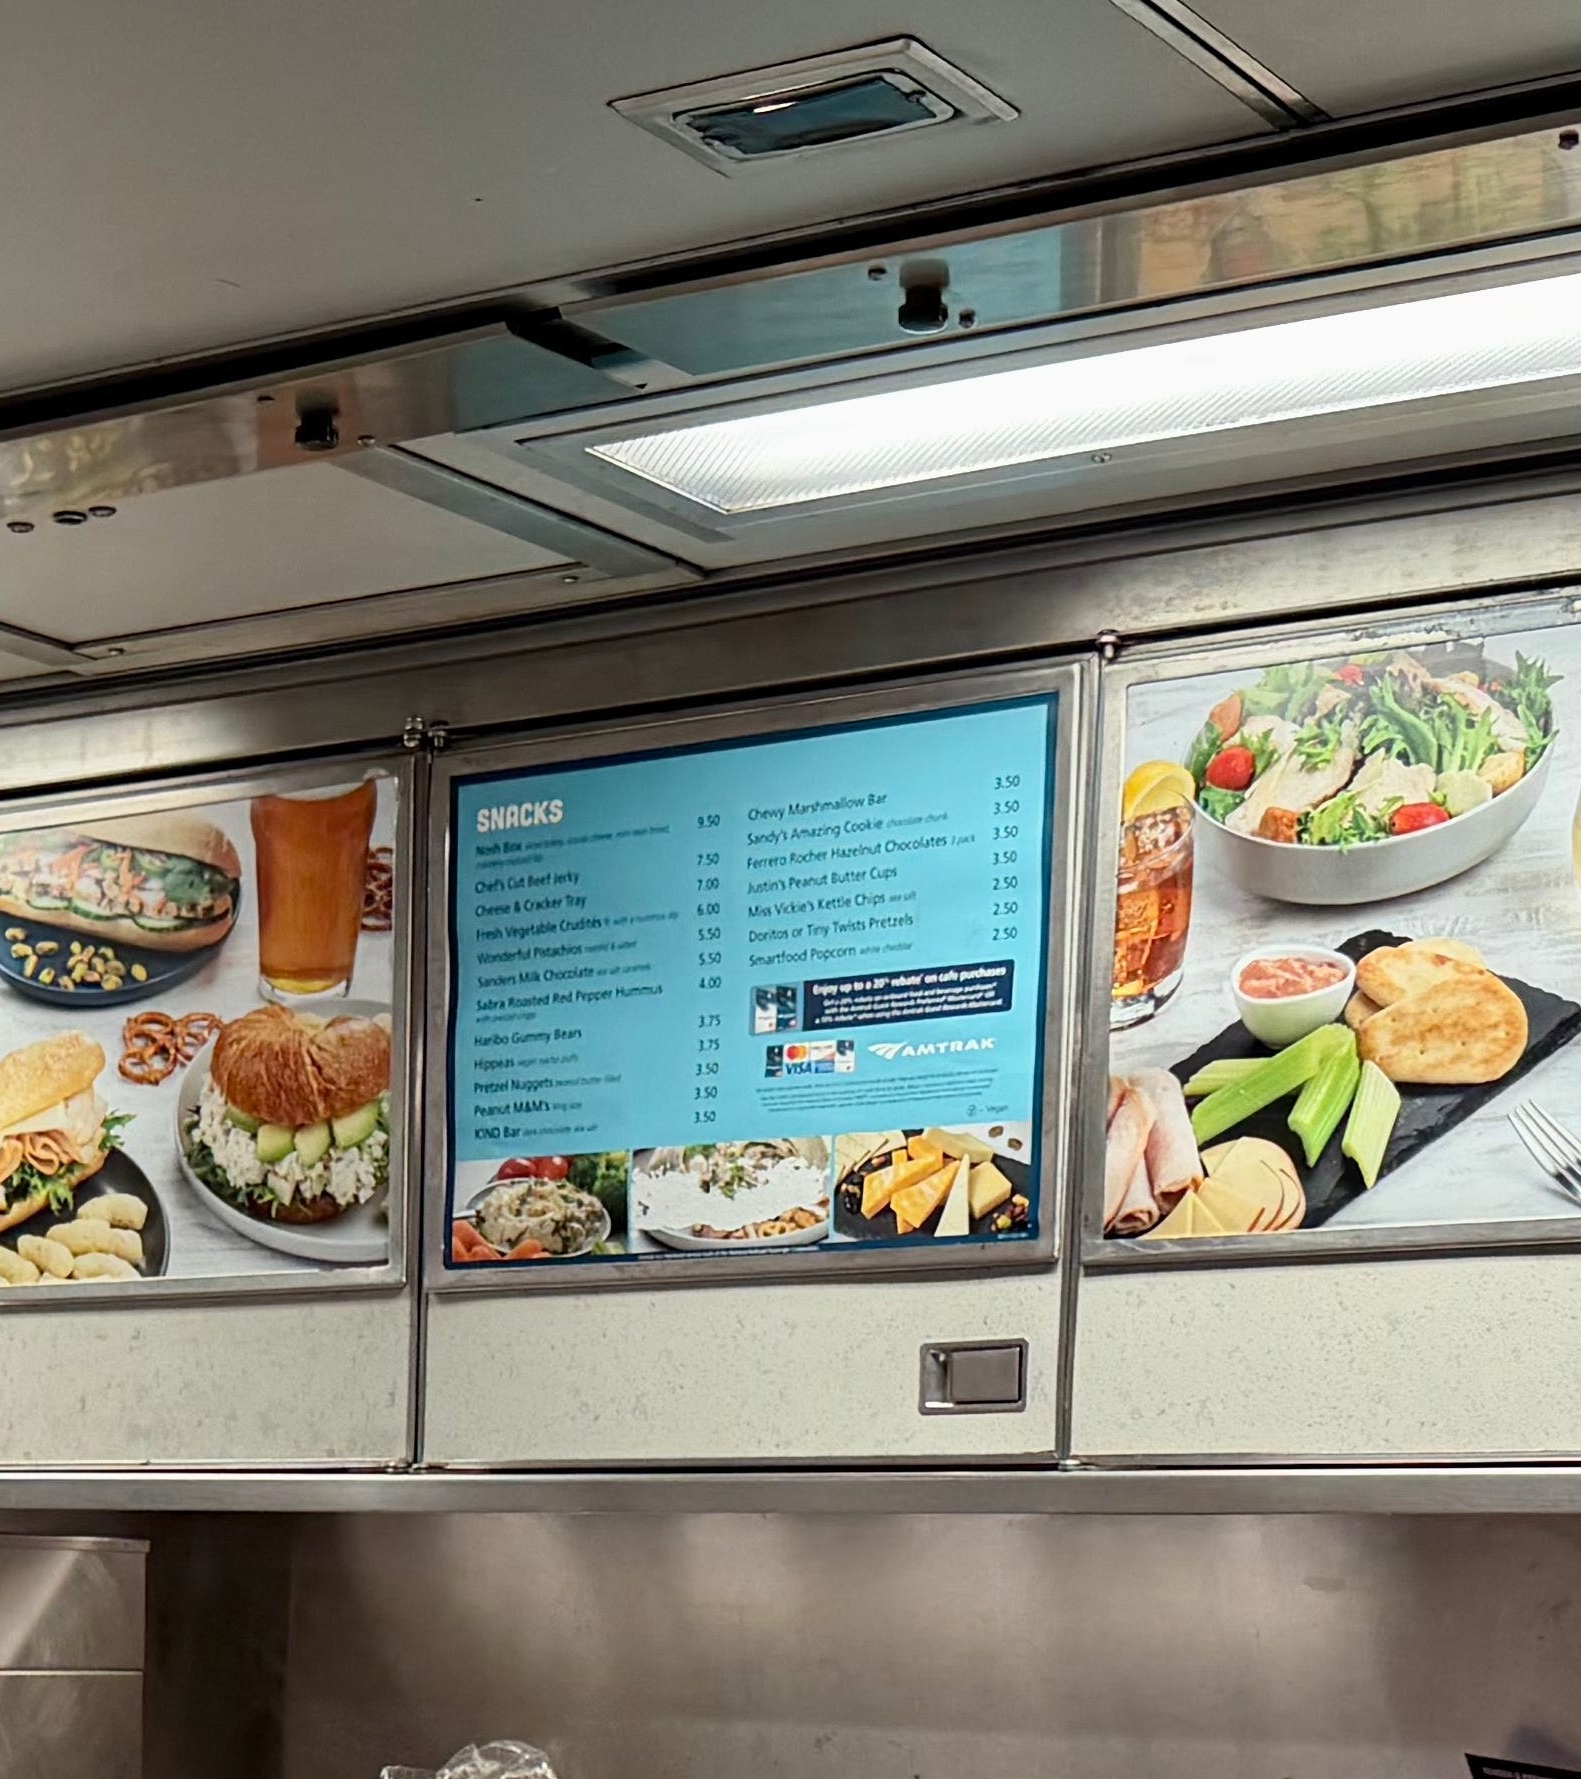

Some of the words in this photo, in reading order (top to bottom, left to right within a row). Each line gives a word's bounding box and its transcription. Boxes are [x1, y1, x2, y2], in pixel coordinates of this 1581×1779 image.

[994, 774, 1020, 789] 3.50
[477, 799, 562, 832] SNACKS
[747, 808, 785, 821] Chewy
[788, 797, 864, 815] Marshmallow
[868, 793, 886, 805] Bar
[790, 825, 840, 839] Amazing
[844, 819, 882, 833] Cookie
[788, 874, 827, 889] Peanut
[831, 871, 866, 883] Butter
[870, 866, 896, 879] Cups
[992, 926, 1017, 940] 2.50
[749, 949, 807, 967] Smartfood
[810, 947, 855, 960] Popcorn
[698, 1014, 720, 1028] 3.75
[474, 1033, 508, 1046] Haribo
[511, 1032, 550, 1043] Gummy
[554, 1028, 581, 1040] Bears
[899, 1038, 994, 1056] AMTRAK
